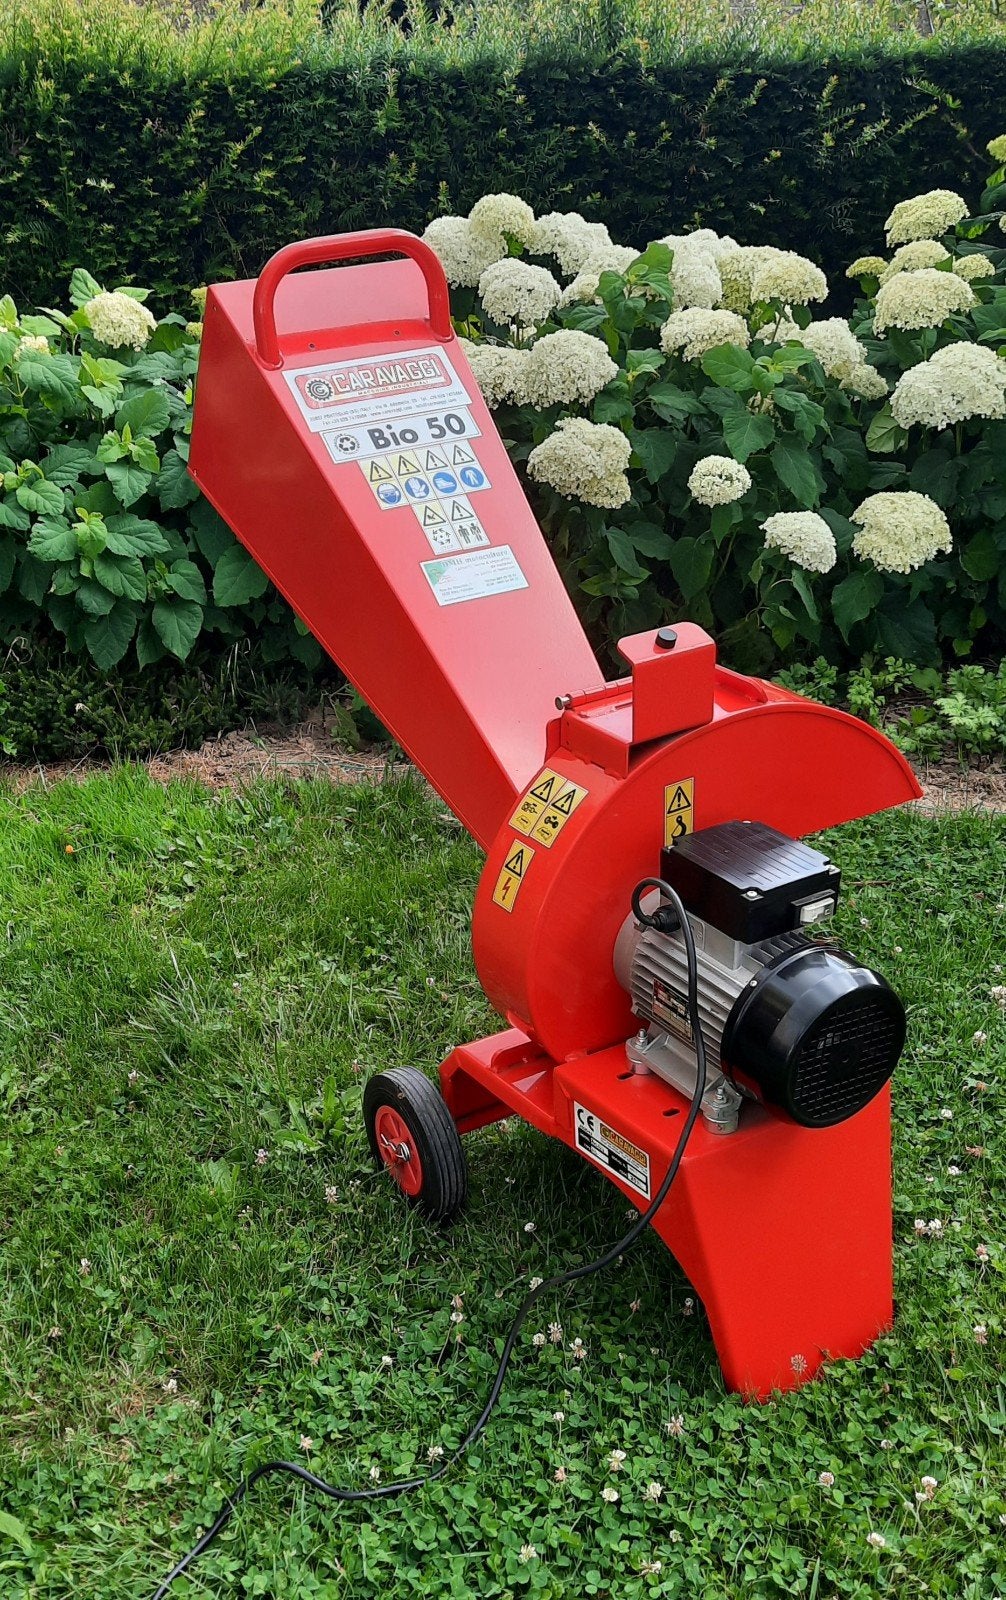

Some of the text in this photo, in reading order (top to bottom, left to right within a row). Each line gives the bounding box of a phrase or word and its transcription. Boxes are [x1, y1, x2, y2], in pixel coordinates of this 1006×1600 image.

[331, 359, 442, 393] CARAVAGGI
[367, 424, 419, 450] Bio
[426, 413, 466, 439] 50
